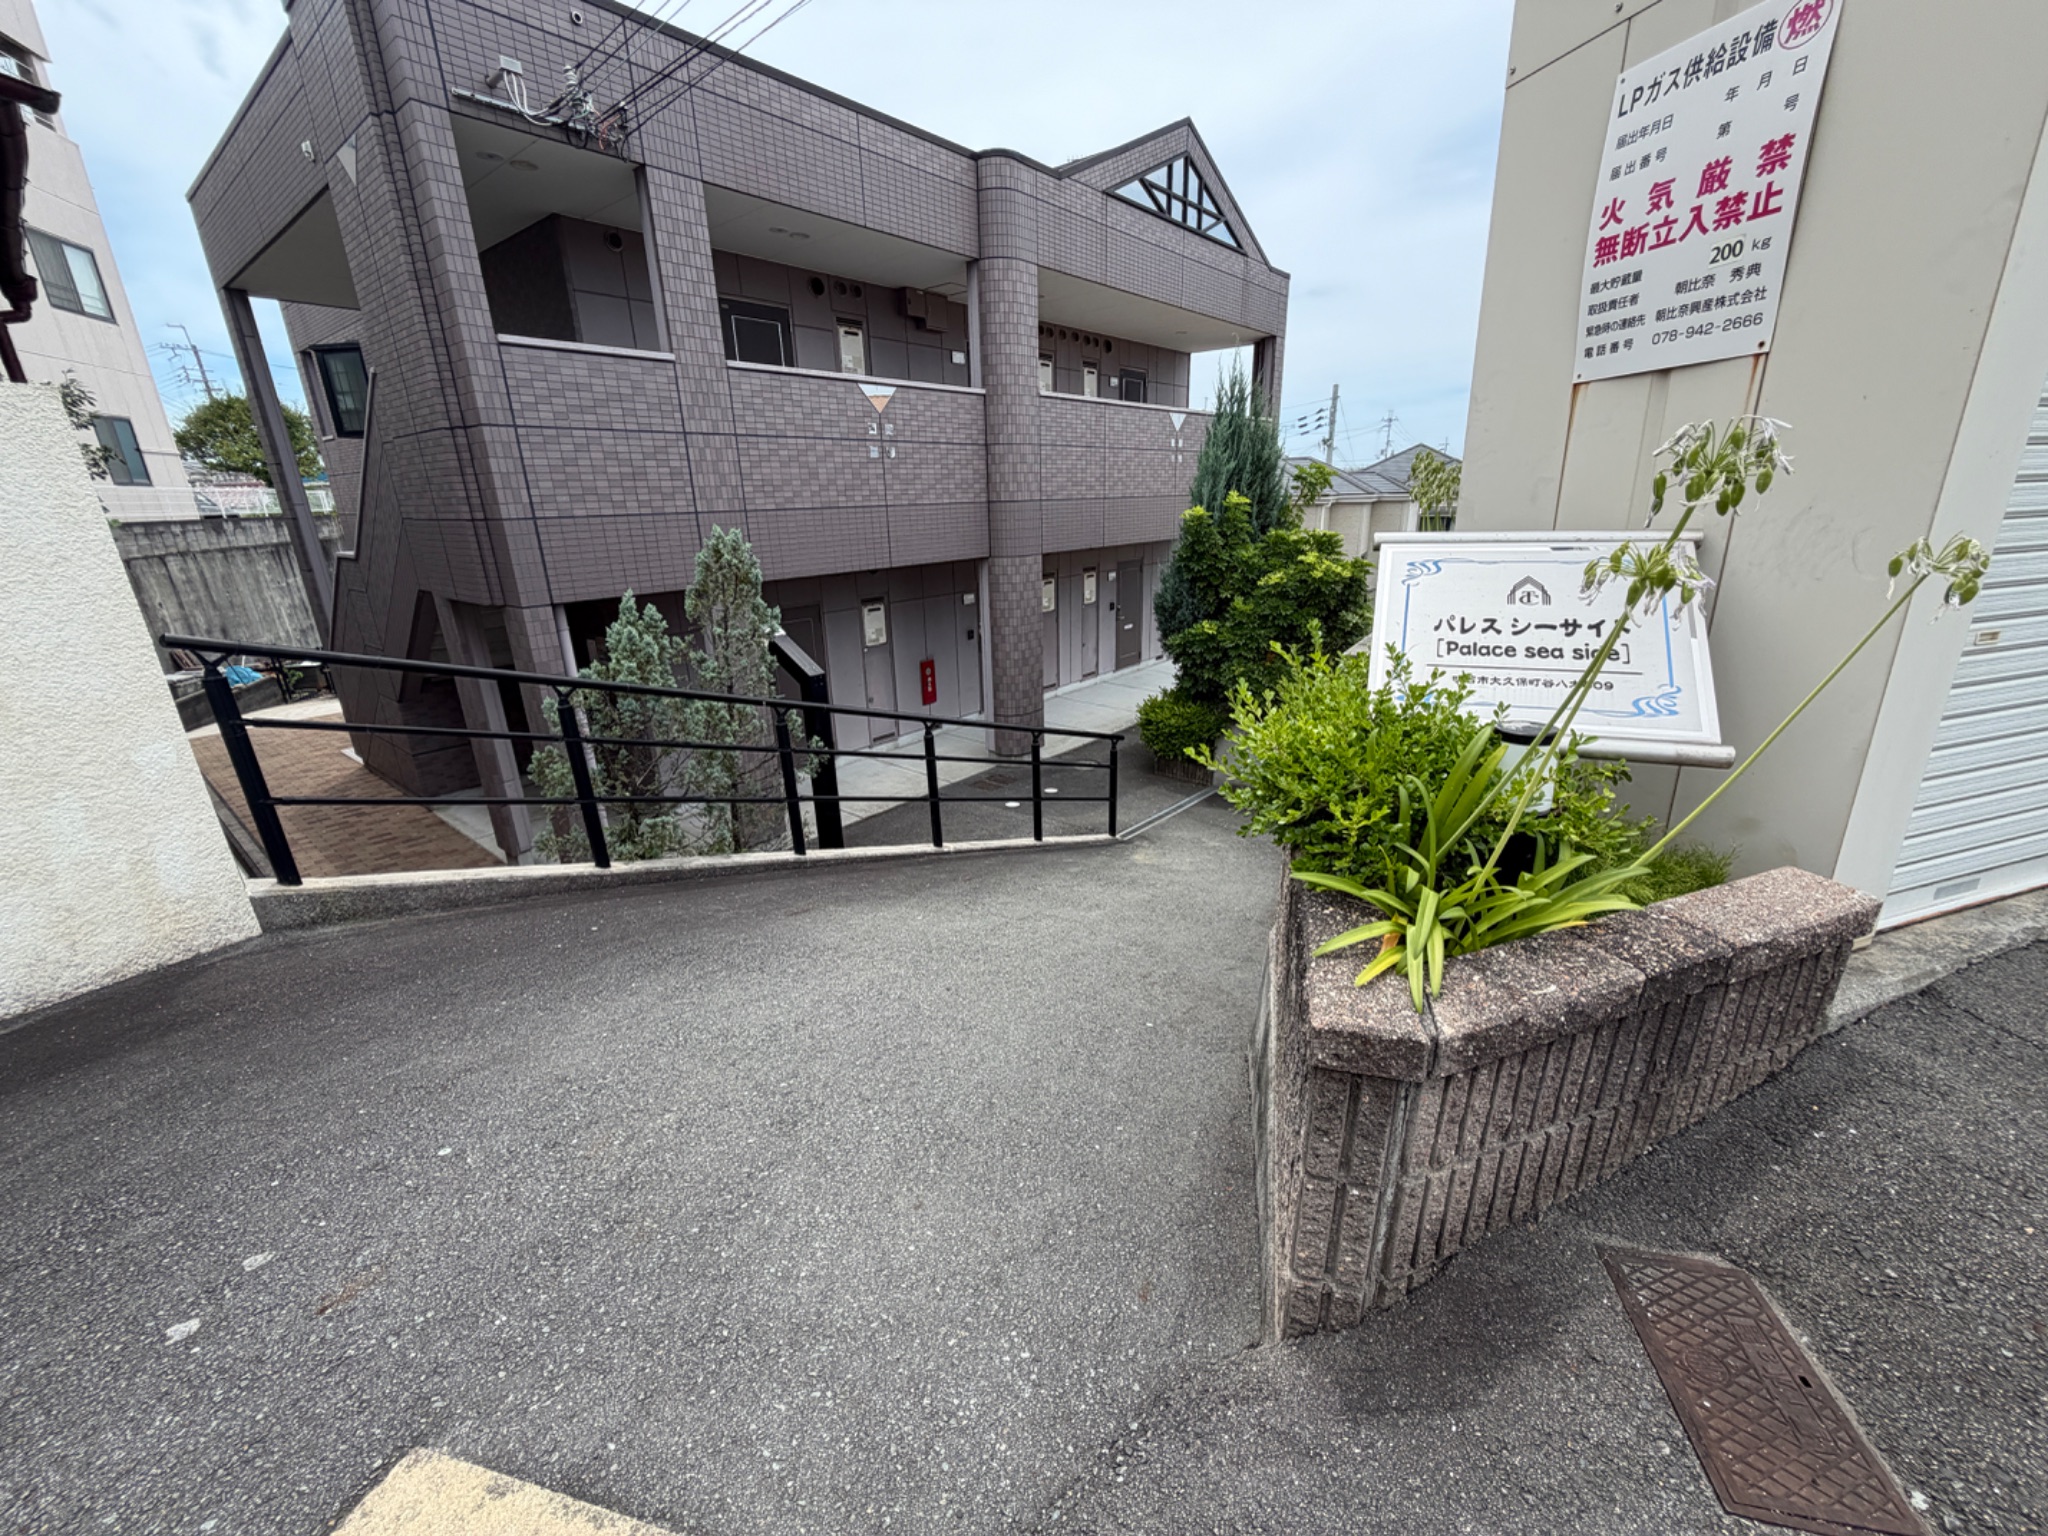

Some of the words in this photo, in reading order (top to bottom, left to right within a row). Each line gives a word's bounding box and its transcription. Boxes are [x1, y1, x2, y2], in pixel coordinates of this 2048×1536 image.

[1784, 0, 1825, 45] 燃
[1617, 18, 1778, 119] LPガス供給設備
[1615, 113, 1674, 151] 届出年月日
[1724, 86, 1740, 103] 年
[1756, 71, 1773, 91] 月
[1792, 55, 1809, 76] 日
[1609, 147, 1668, 182] 届出番号
[1716, 120, 1733, 140] 第
[1784, 93, 1800, 112] 号
[1598, 133, 1796, 231] 火気厳禁
[1592, 181, 1784, 269] 無断立入禁止
[1587, 293, 1640, 317] 取扱責任者
[1674, 272, 1716, 296] 朝比奈
[1729, 262, 1762, 283] 秀典
[1589, 269, 1643, 295] 最大貯蔵量
[1709, 239, 1744, 265] 200
[1751, 236, 1772, 252] kg
[1584, 338, 1634, 360] 電話番号
[1651, 312, 1764, 345] 078-942-2666
[1585, 314, 1646, 338] 緊急時の連絡先
[1655, 286, 1767, 322] 朝比奈興産株式会社
[1433, 614, 1502, 635] パレス
[1524, 645, 1564, 660] sea
